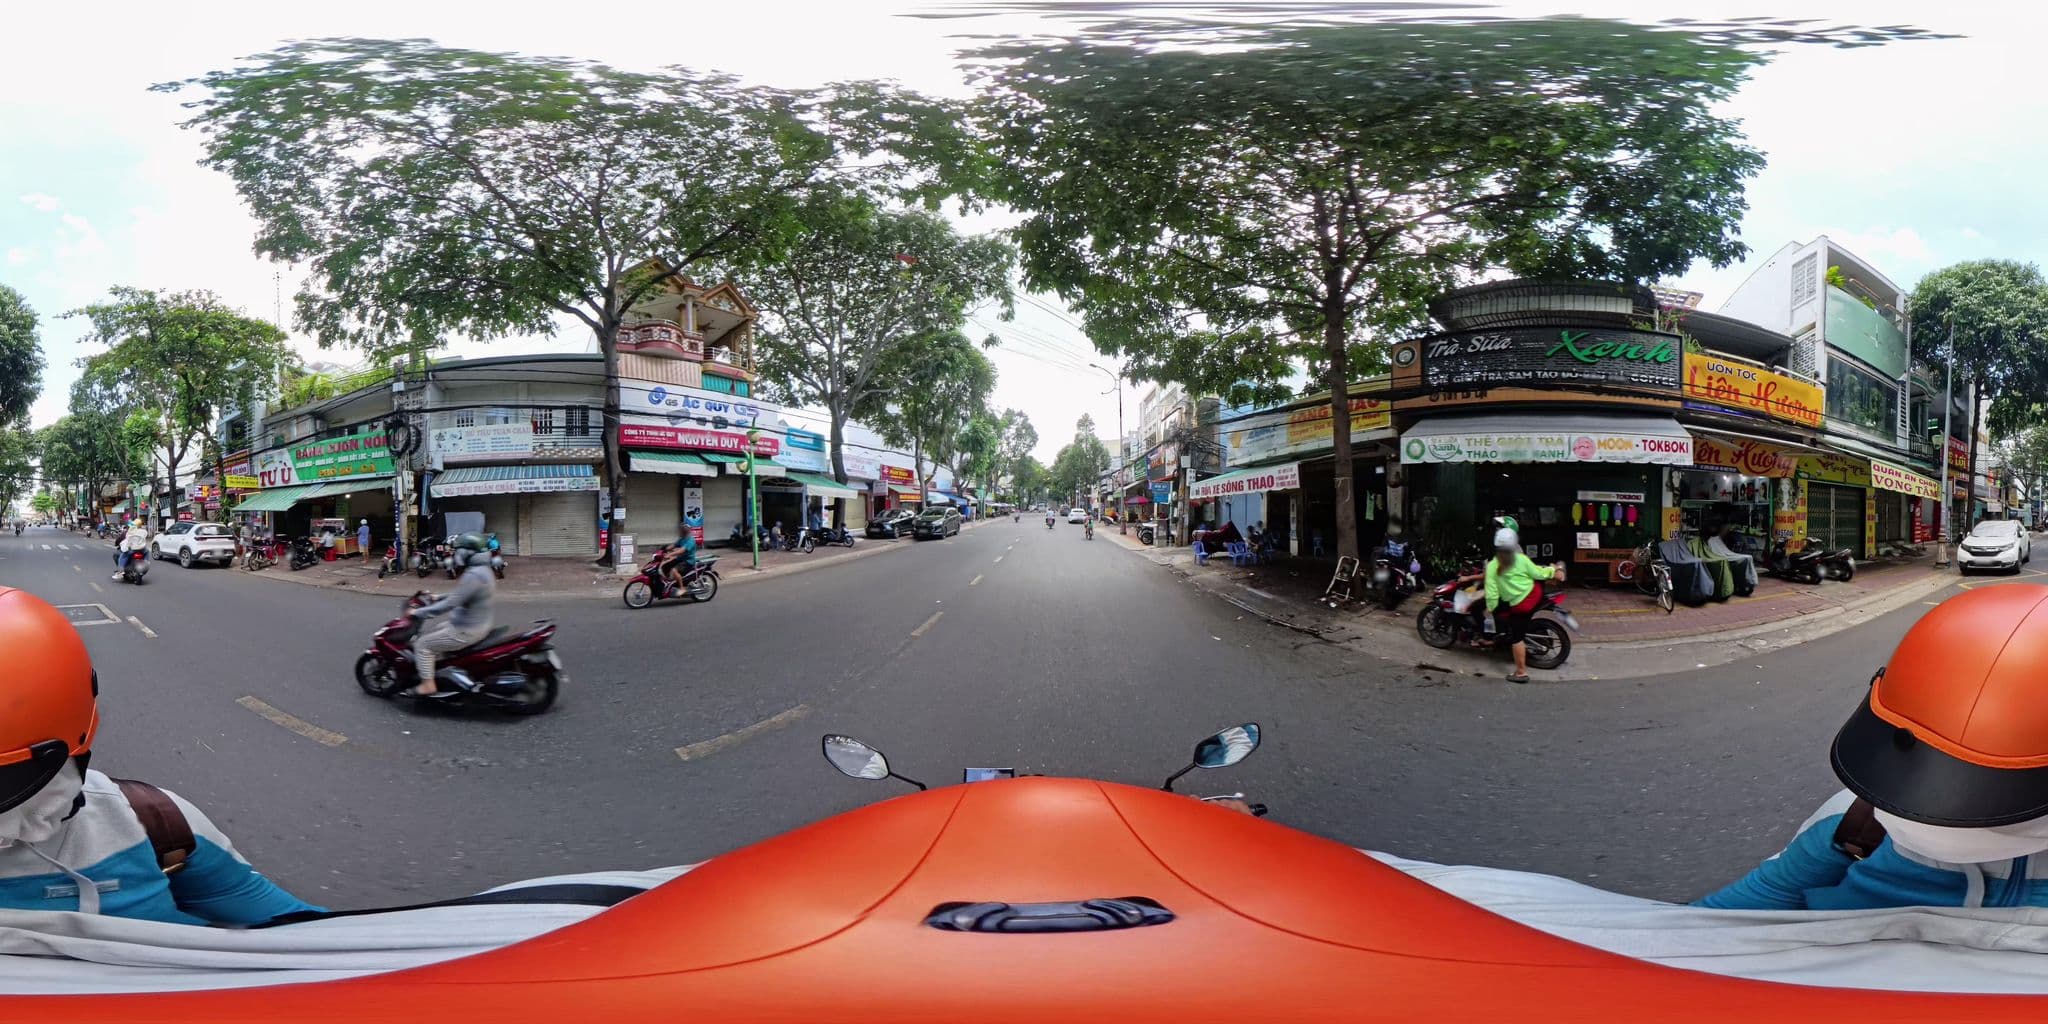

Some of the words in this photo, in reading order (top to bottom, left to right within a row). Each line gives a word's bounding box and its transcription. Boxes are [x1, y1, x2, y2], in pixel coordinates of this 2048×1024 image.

[1428, 338, 1460, 358] Trà
[1467, 335, 1513, 353] Sữa
[1545, 330, 1678, 363] Xanh
[705, 401, 729, 413] QUY
[1689, 365, 1741, 404] Liên
[1750, 380, 1819, 428] Hương
[721, 436, 739, 449] DUY
[1597, 438, 1633, 450] MOON
[1642, 439, 1688, 453] TOKBOKI
[259, 467, 278, 487] TƯ
[281, 462, 292, 485] Ù
